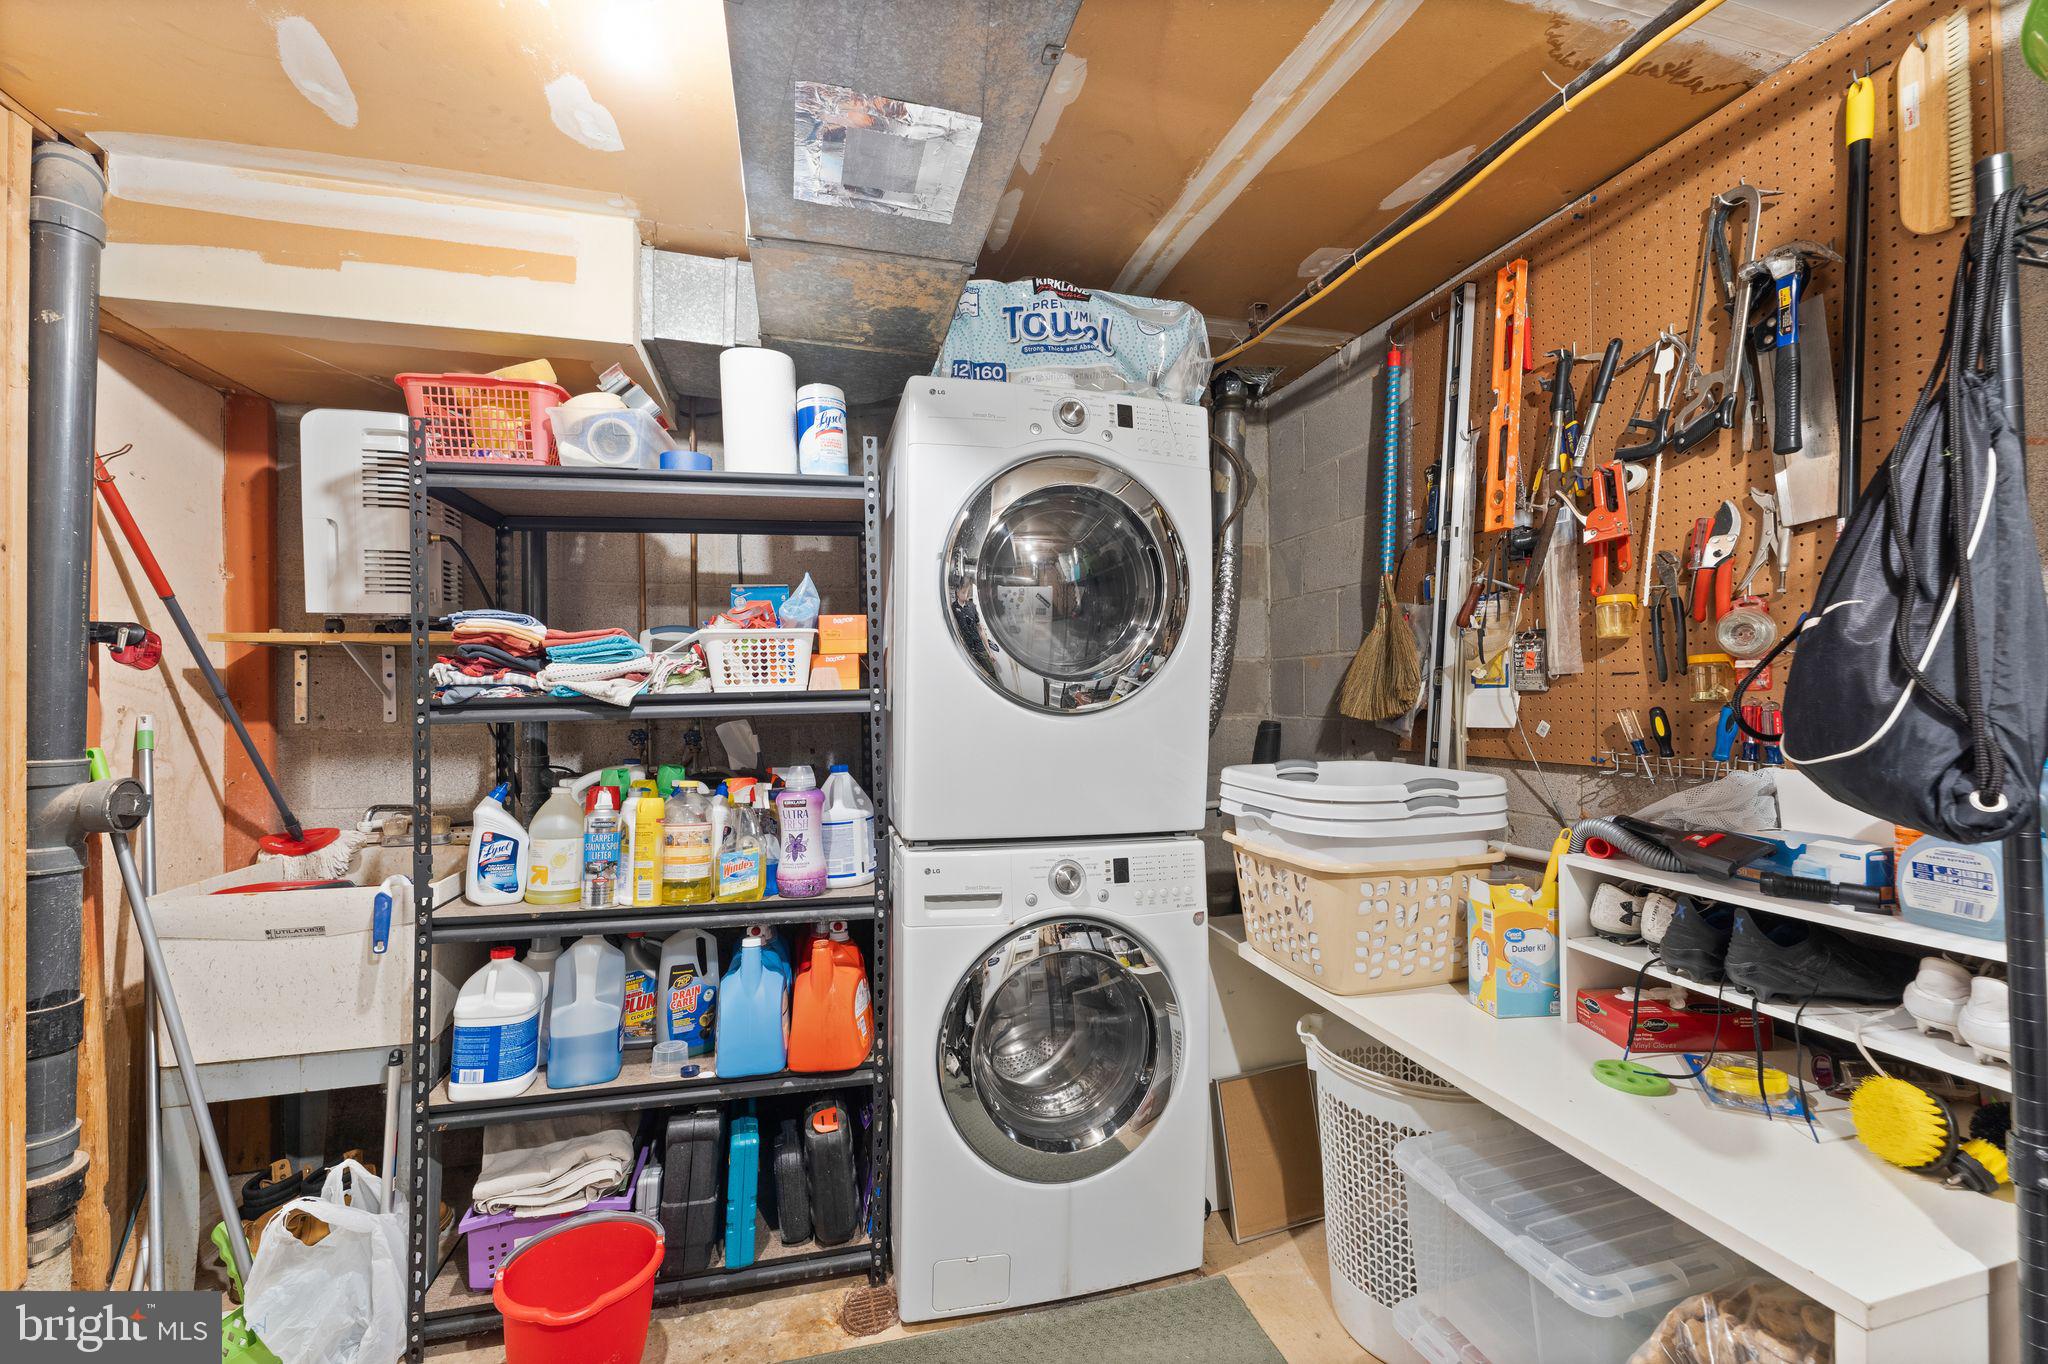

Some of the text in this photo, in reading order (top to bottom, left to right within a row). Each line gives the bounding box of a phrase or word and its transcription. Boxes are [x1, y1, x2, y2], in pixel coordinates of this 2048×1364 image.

[1066, 344, 1078, 352] and
[952, 363, 969, 377] 12
[974, 365, 1004, 380] 160
[820, 411, 842, 428] Lysol
[782, 809, 809, 819] ULTRA
[783, 819, 809, 829] FRESH
[591, 833, 615, 842] CARPET
[484, 841, 511, 858] Lysol
[585, 843, 601, 851] STAIN
[601, 843, 606, 851] &
[591, 851, 612, 860] LIFTER
[723, 859, 755, 880] Windex
[1511, 943, 1546, 953] Duster Kit
[672, 985, 701, 1001] DRAIN
[670, 996, 693, 1010] CARE
[630, 1012, 645, 1020] CLOG
[1633, 1041, 1677, 1050] Vinyl Gloves
